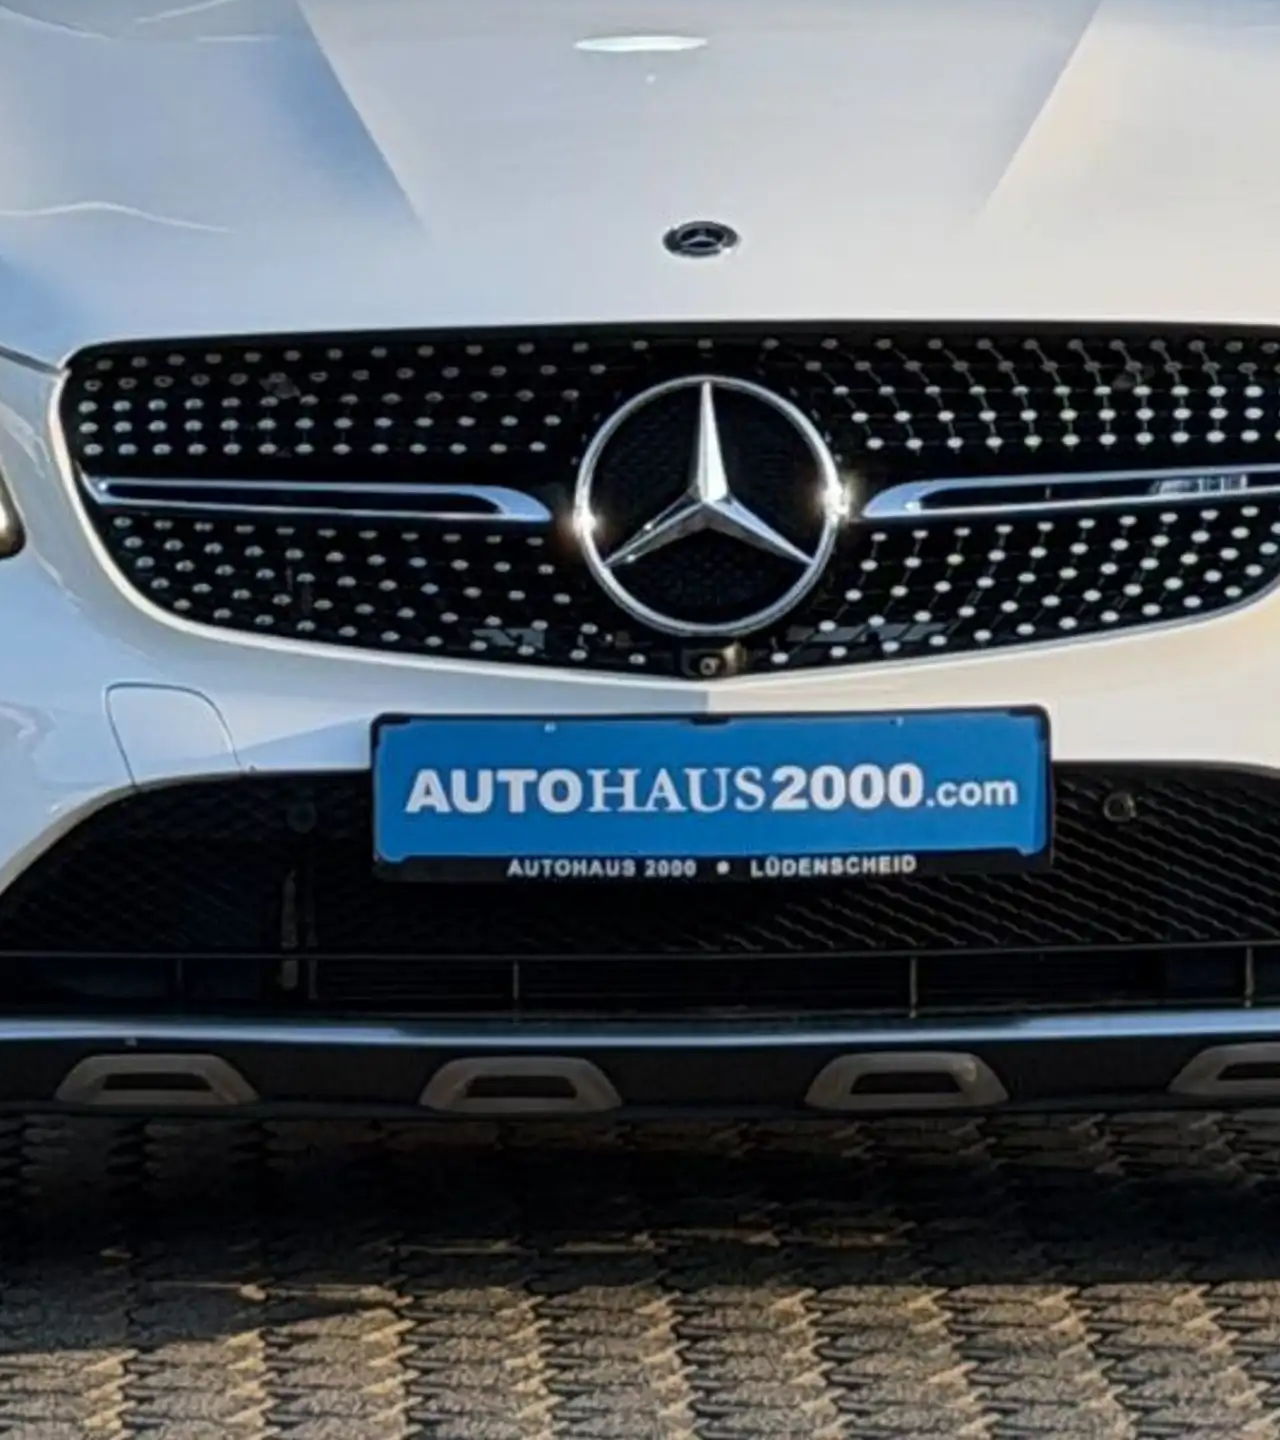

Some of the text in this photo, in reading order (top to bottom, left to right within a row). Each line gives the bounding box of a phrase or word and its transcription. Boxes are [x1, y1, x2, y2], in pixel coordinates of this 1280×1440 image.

[405, 762, 1018, 814] AUTOHAUS2000.com
[507, 854, 918, 878] AUTOHAUS 2000 LÜDENSCHEID
